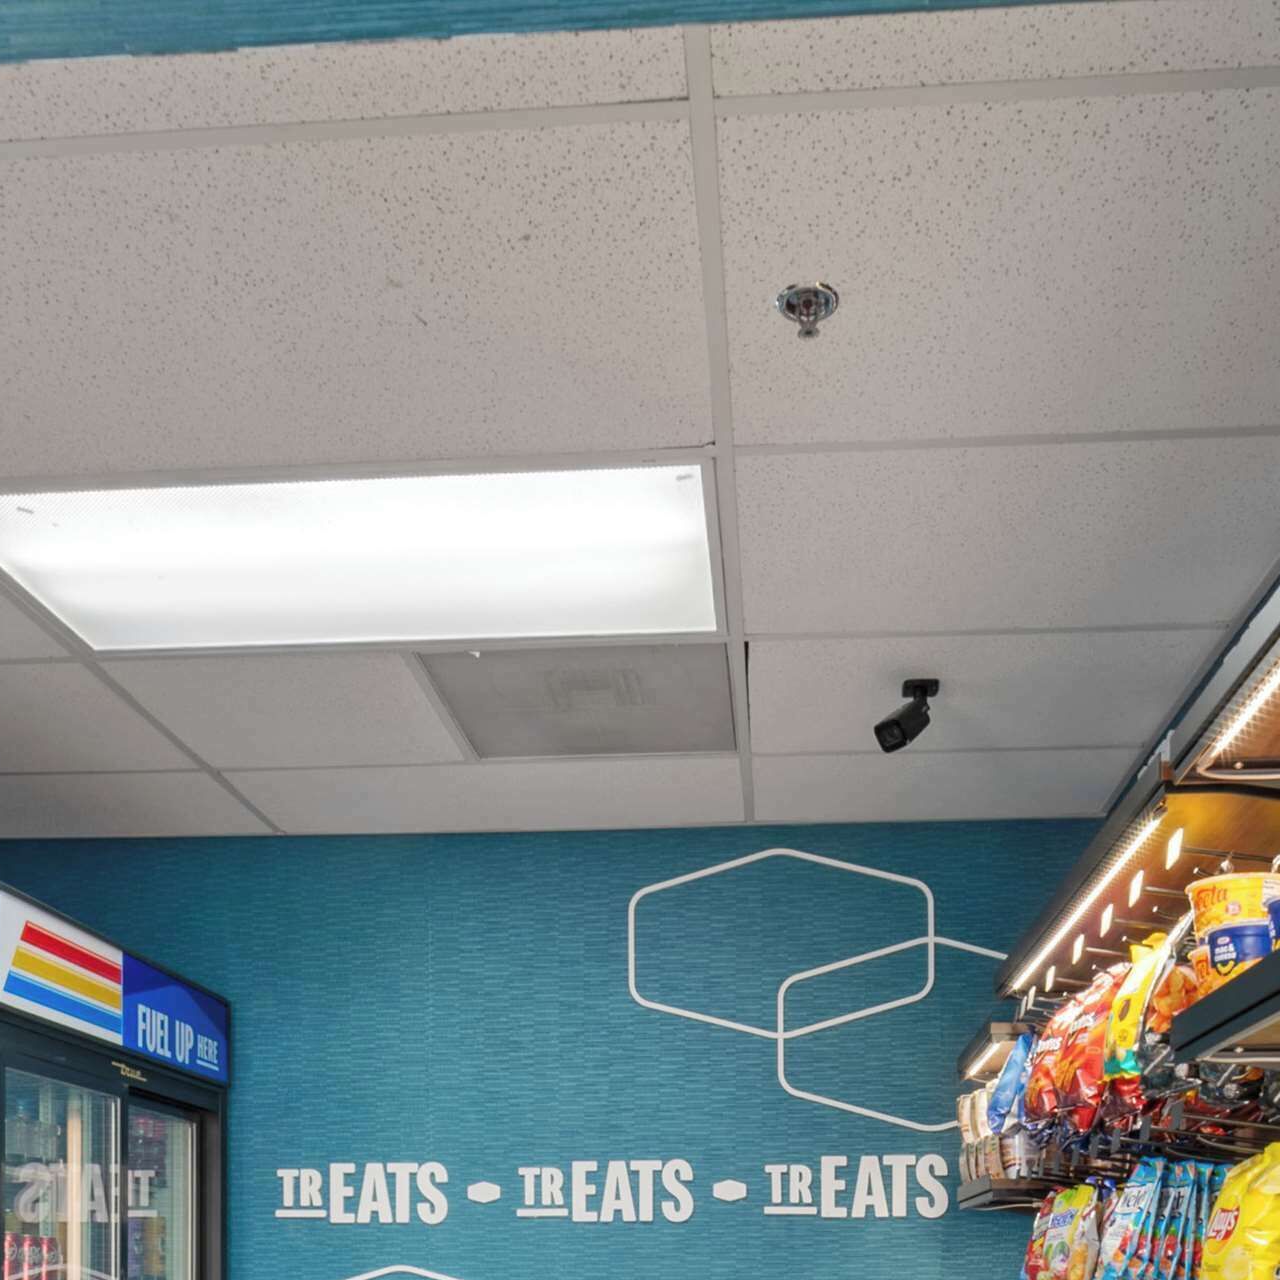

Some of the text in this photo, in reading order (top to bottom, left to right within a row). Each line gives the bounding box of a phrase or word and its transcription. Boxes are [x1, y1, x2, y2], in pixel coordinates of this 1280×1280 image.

[137, 1003, 219, 1071] FUEL UP HERE
[276, 1161, 448, 1226] TREATS
[517, 1158, 695, 1224] TREATS
[763, 1154, 949, 1219] TREATS
[1207, 1209, 1239, 1241] Lay's
